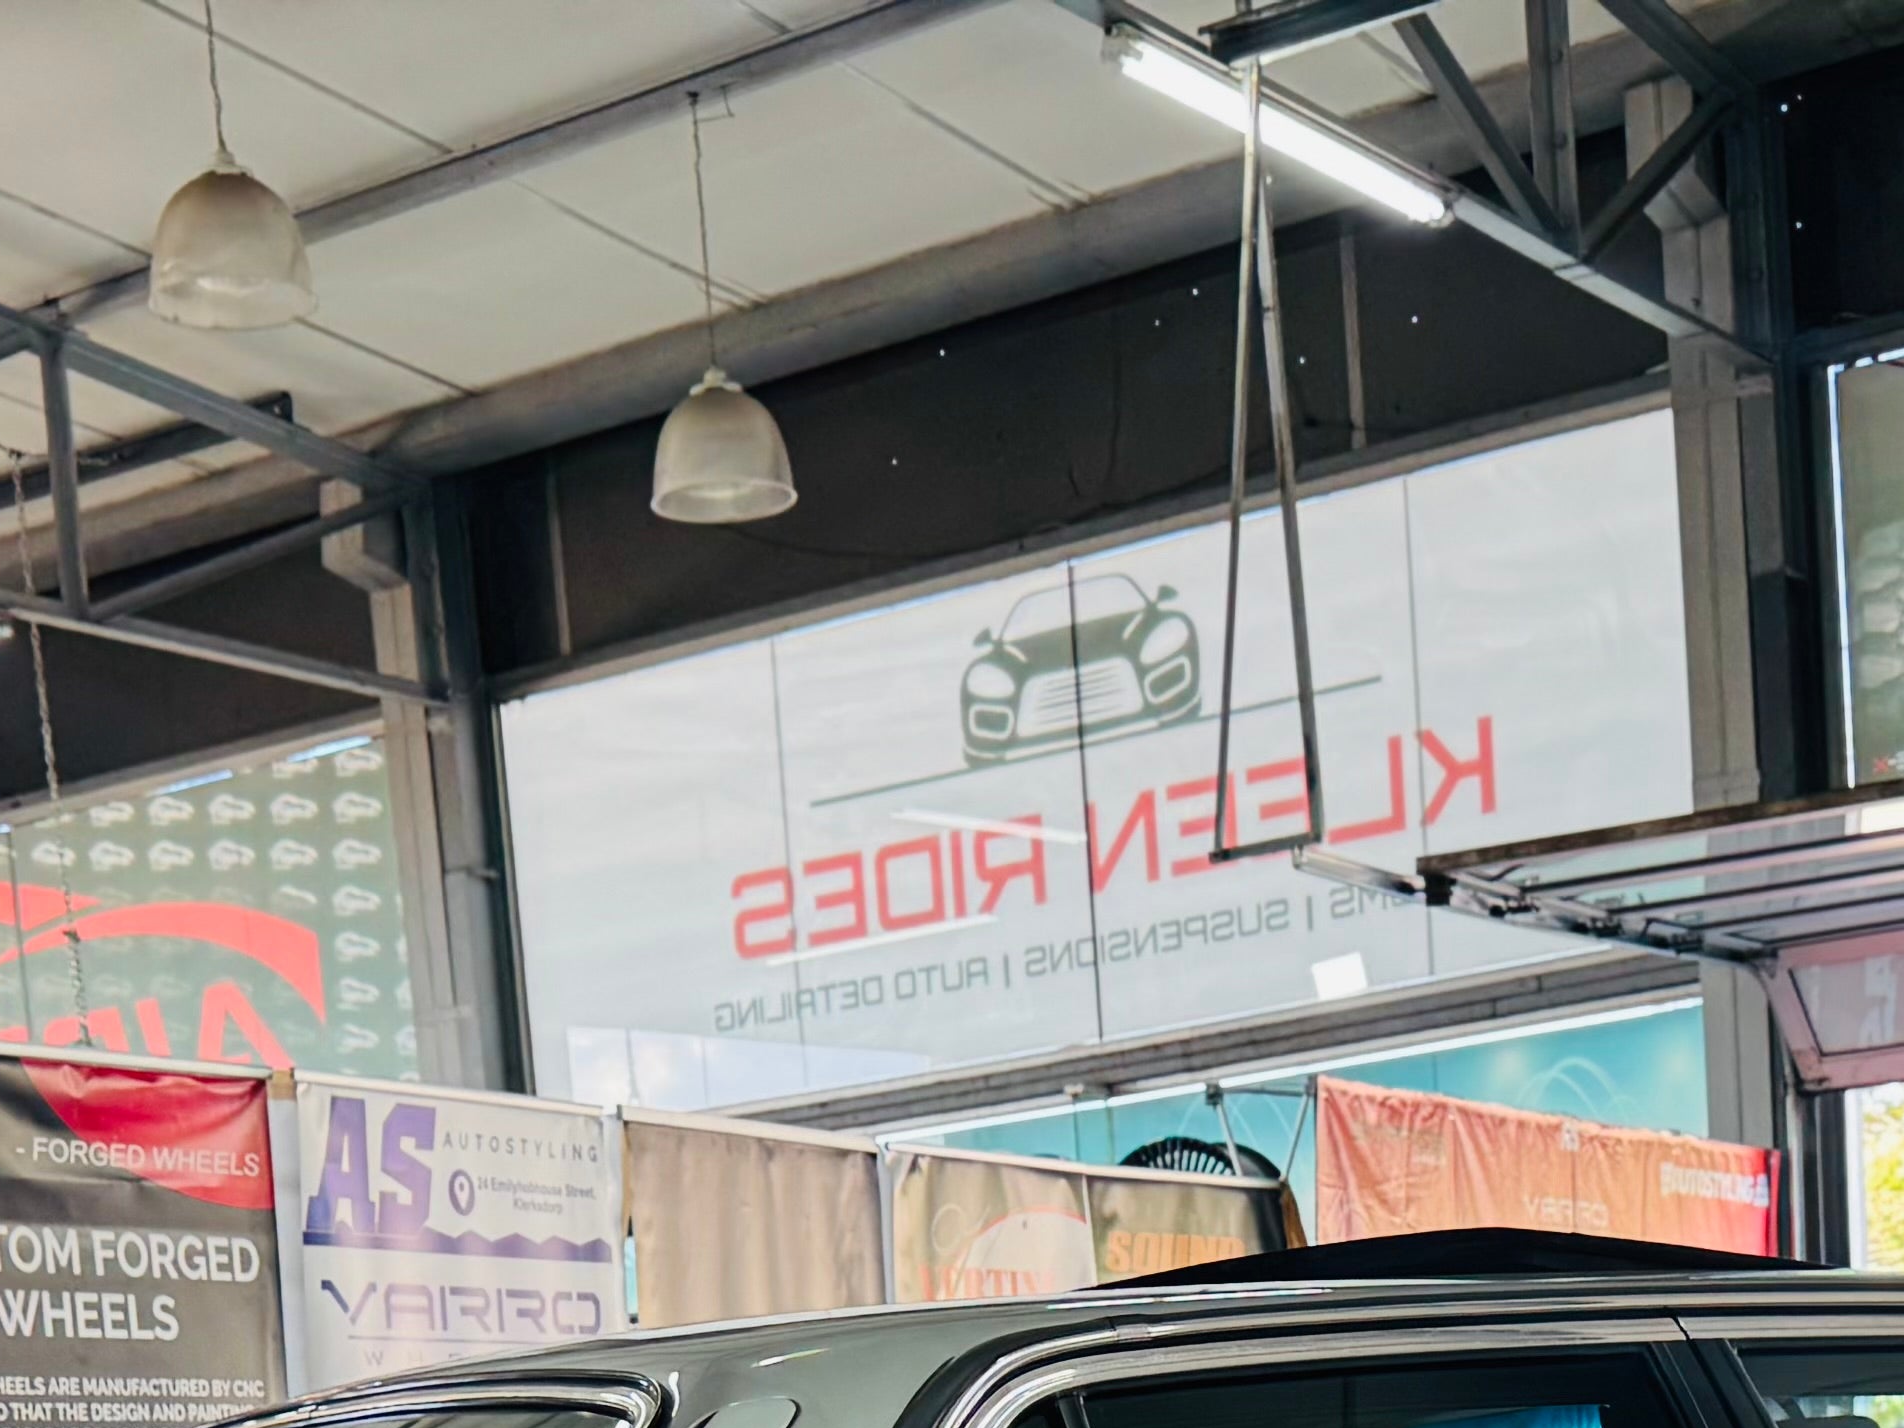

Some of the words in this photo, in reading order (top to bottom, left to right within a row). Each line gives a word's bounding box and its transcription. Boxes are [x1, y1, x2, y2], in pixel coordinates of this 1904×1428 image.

[33, 1138, 144, 1168] FORGED
[153, 1145, 260, 1177] WHEELS
[307, 1096, 437, 1234] AS
[442, 1131, 598, 1162] AUTOSTYLING
[93, 1230, 260, 1284] FORGED
[321, 1280, 600, 1334] VARRO
[50, 1378, 80, 1396] ARE
[84, 1378, 208, 1397] MANUFACTURED
[212, 1379, 231, 1398] BY
[233, 1380, 264, 1398] CNC
[9, 1402, 50, 1420] THAT
[55, 1402, 88, 1421] THE
[91, 1403, 149, 1421] DESIGN
[153, 1403, 186, 1420] AND
